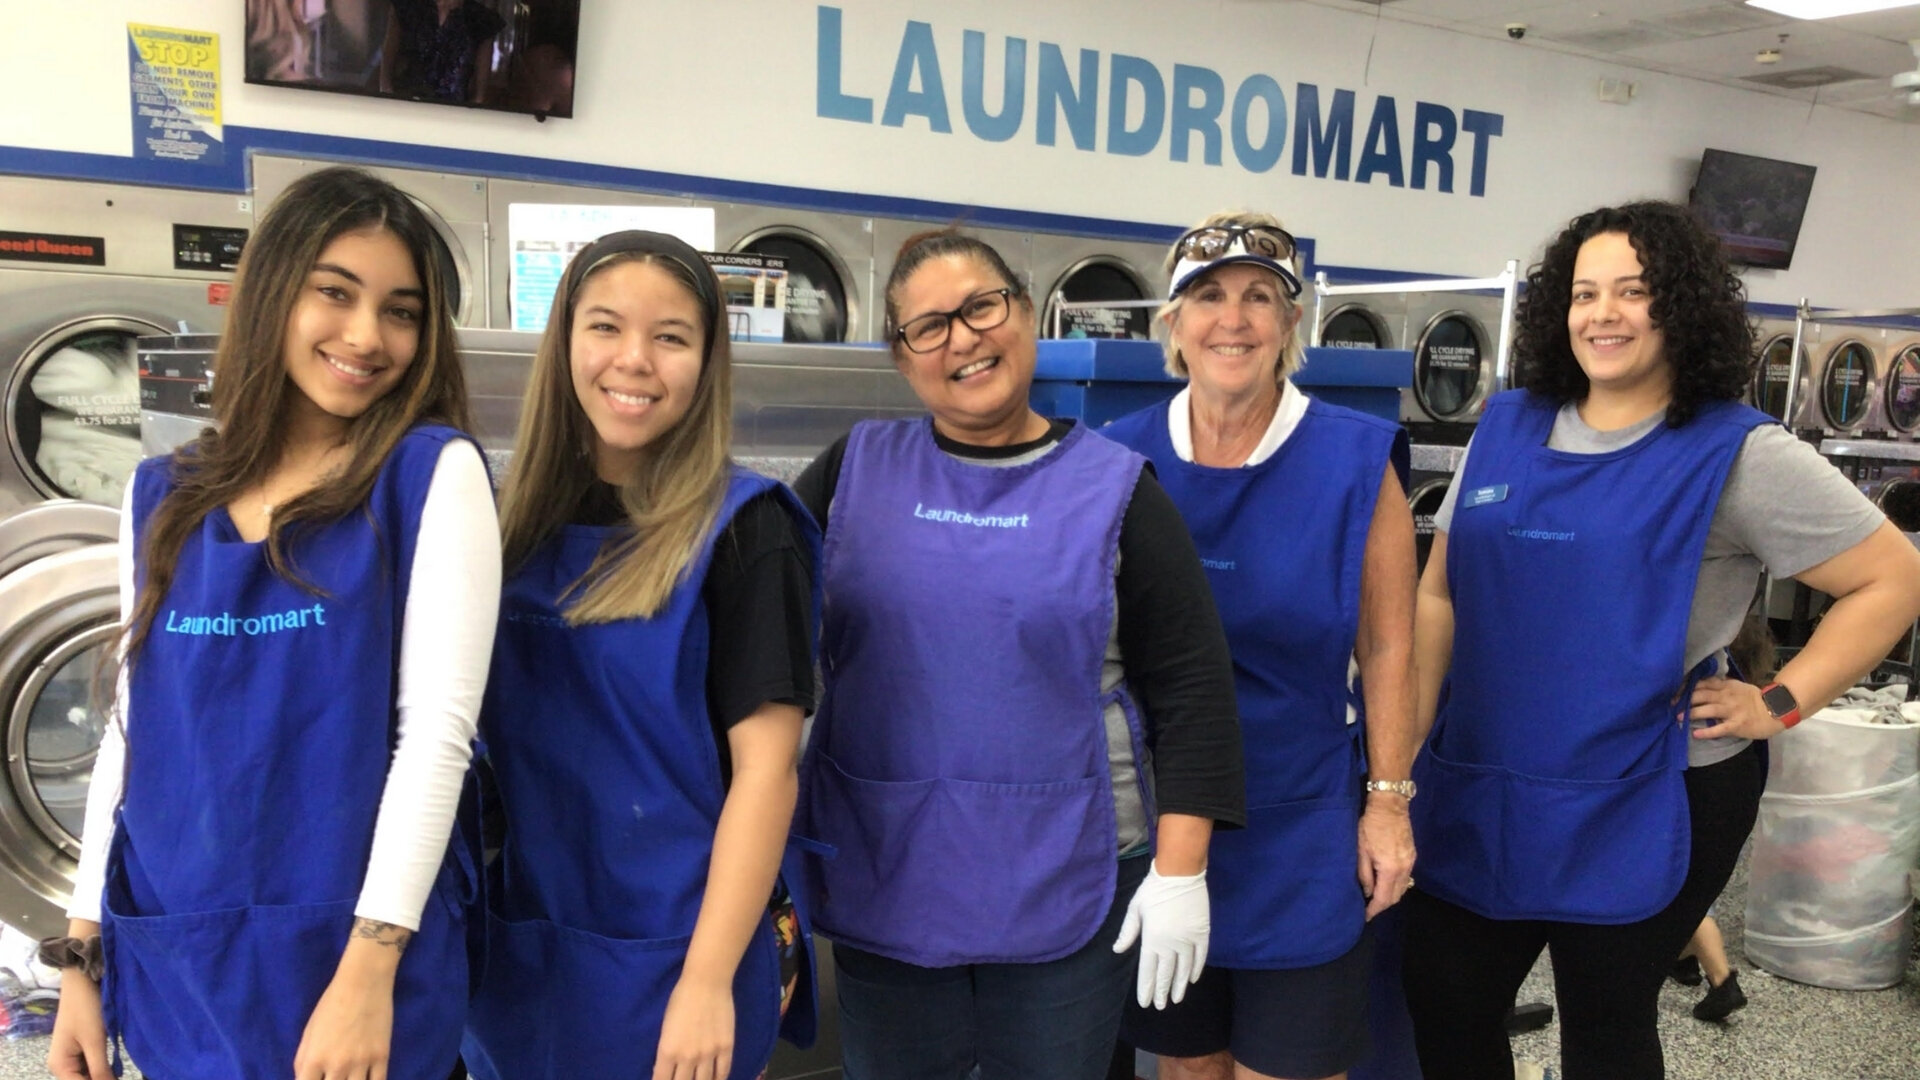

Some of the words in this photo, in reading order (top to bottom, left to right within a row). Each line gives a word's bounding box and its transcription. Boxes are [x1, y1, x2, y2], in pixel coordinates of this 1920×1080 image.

[140, 39, 208, 67] STOP
[153, 65, 173, 76] NOT
[177, 67, 215, 79] REMOVE
[188, 79, 218, 90] OTHER
[163, 86, 188, 97] YOUR
[192, 89, 216, 100] OWN
[168, 97, 216, 111] MACHINES
[817, 6, 1504, 197] LAUNDROMART
[0, 238, 36, 253] eed
[36, 239, 94, 256] Queen
[725, 255, 763, 267] CORNERS
[57, 395, 90, 407] FULL
[90, 395, 129, 407] CYCLE
[77, 407, 93, 416] WE
[95, 406, 141, 416] GUARANT
[103, 415, 118, 426] for
[120, 415, 133, 426] 32
[913, 502, 1029, 528] Laundromart
[166, 603, 326, 635] Laundromart
